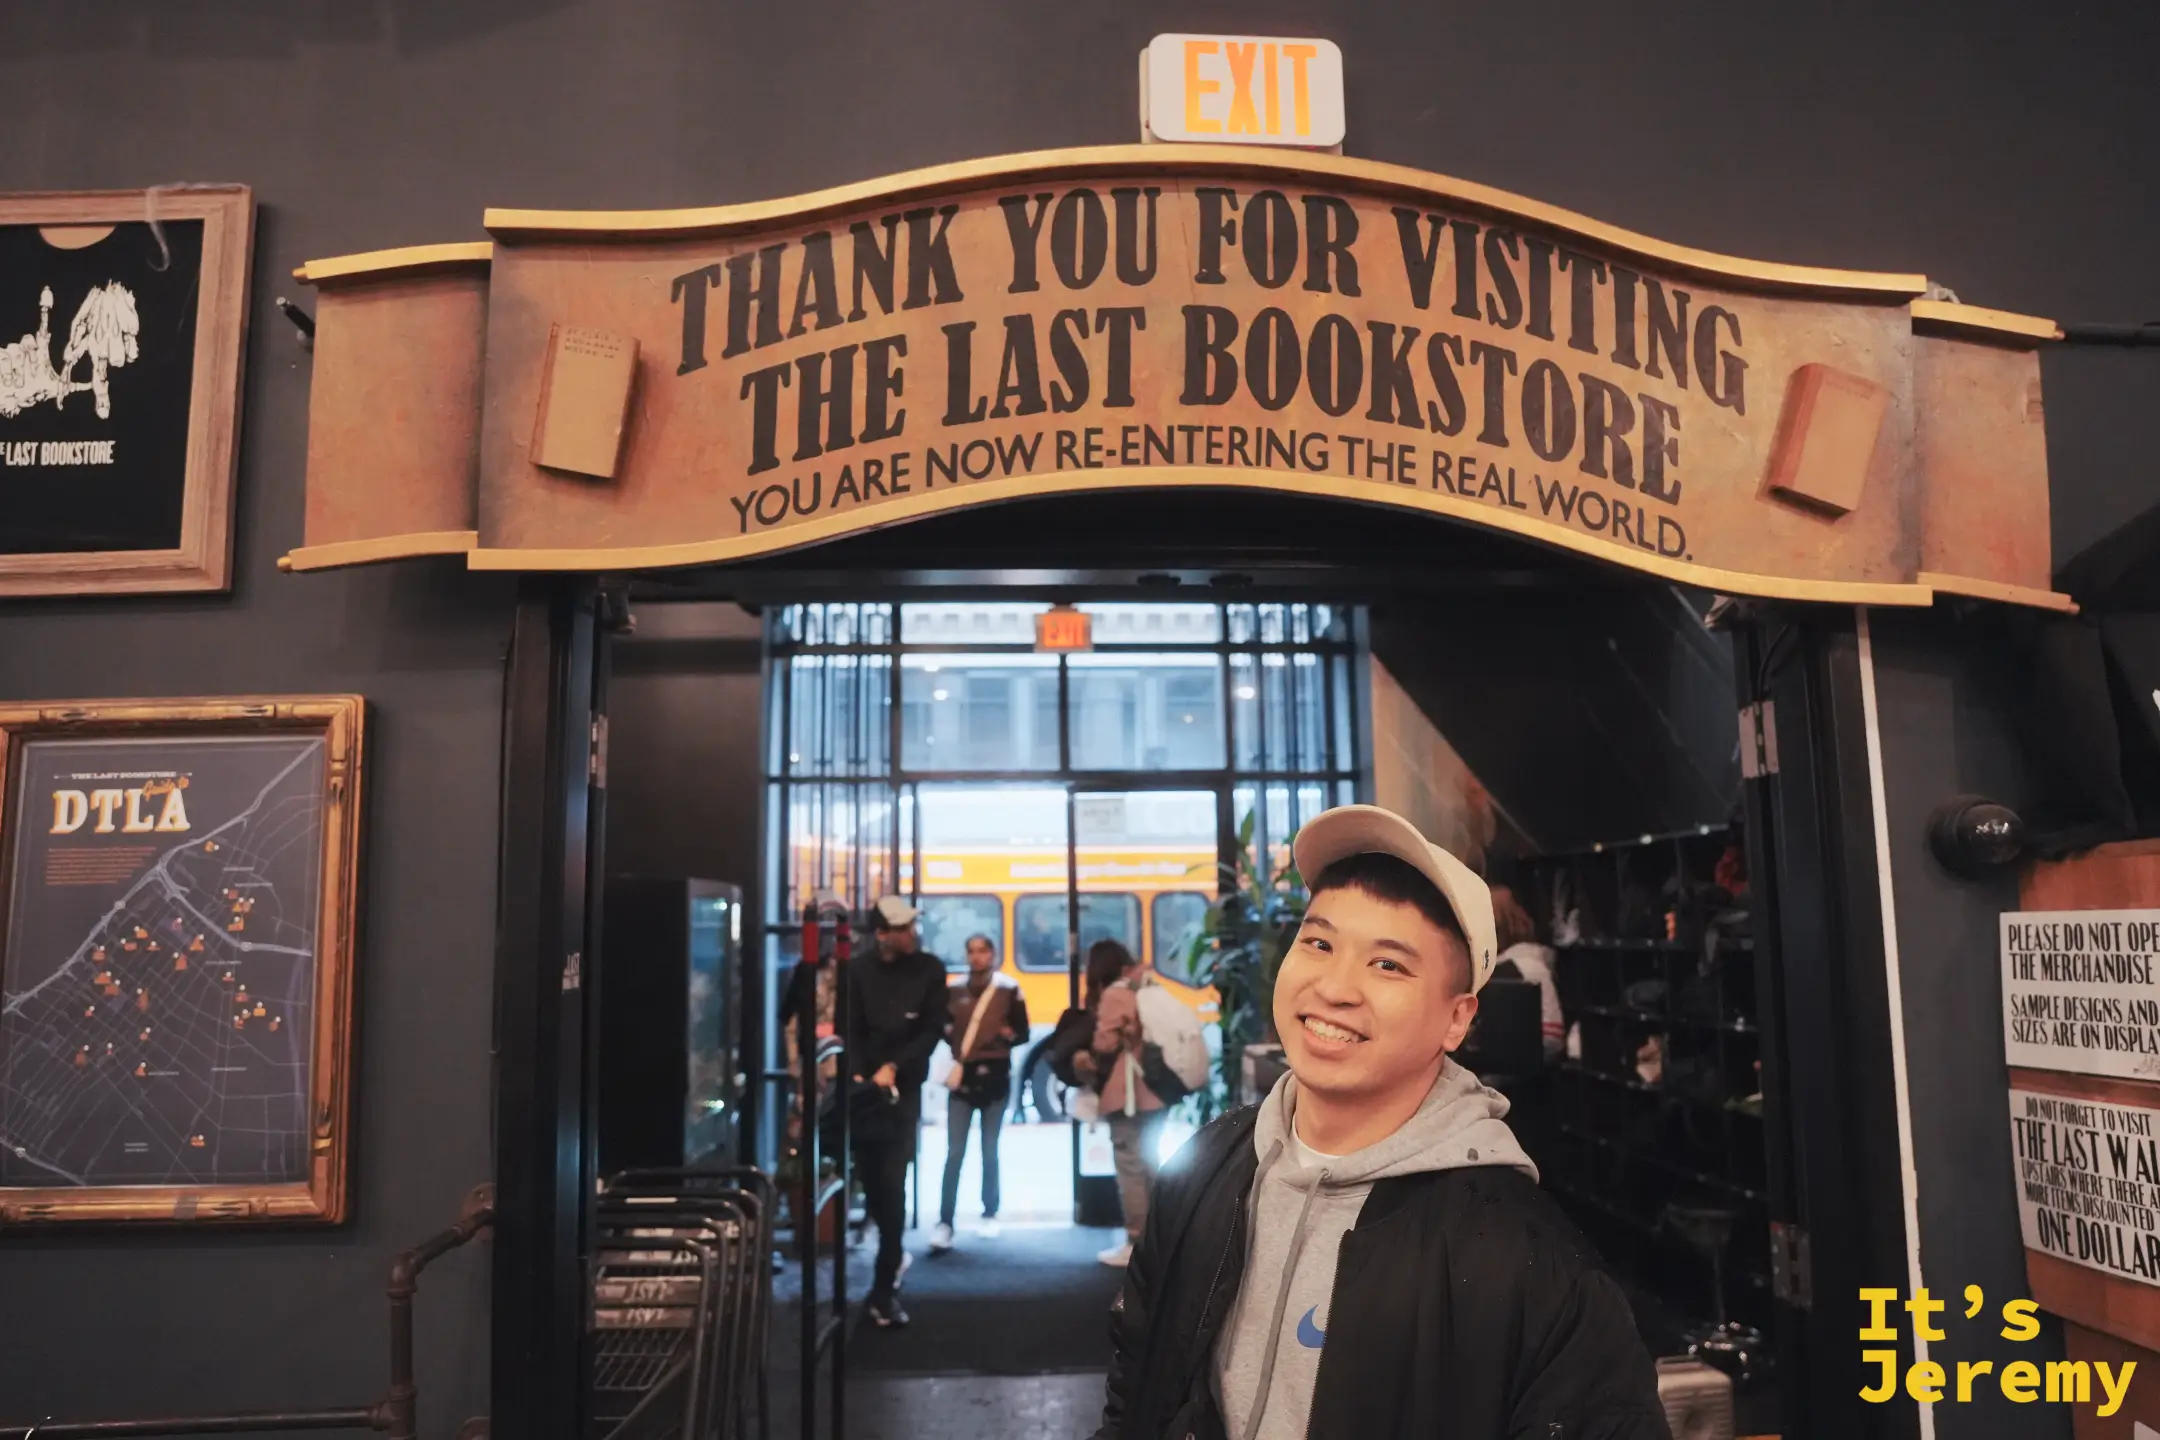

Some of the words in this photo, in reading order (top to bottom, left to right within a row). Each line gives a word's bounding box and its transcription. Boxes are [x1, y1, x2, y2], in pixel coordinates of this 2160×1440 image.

[1183, 40, 1317, 137] EXIT
[669, 204, 964, 377] THANK
[998, 186, 1161, 295] YOU
[1194, 186, 1361, 298] FOR
[1391, 205, 1750, 416] VISITING
[739, 333, 909, 477] THE
[940, 306, 1147, 427] LAST
[1178, 304, 1683, 507] BOOKSTORE
[5, 441, 39, 466] LAST
[40, 440, 116, 466] BOOKSTORE
[730, 473, 823, 534] YOU
[829, 452, 911, 509] ARE
[925, 431, 1044, 488] NOW
[1054, 424, 1331, 472] RE-ENTERING
[1331, 435, 1416, 485] THE
[1430, 453, 1527, 511] REAL
[1534, 473, 1694, 562] WORLD.
[49, 788, 191, 833] DTLA
[2008, 923, 2060, 951] PLEASE
[2064, 923, 2084, 951] DO
[2088, 922, 2122, 952] NOT
[2009, 953, 2037, 981] THE
[2040, 953, 2155, 985] MERCHANDISE
[2010, 993, 2060, 1021] SAMPLE
[2063, 996, 2123, 1025] DESIGNS
[2127, 999, 2159, 1026] AND
[2012, 1018, 2048, 1045] SIZES
[2052, 1021, 2078, 1048] ARE
[2080, 1023, 2100, 1049] ON
[2104, 1025, 2160, 1055] DISPLA
[2025, 1096, 2038, 1118] DO
[2039, 1099, 2058, 1122] NOT
[2060, 1102, 2096, 1128] FORGET
[2099, 1107, 2116, 1131] TO
[2118, 1111, 2151, 1136] VISIT
[2013, 1117, 2048, 1163] THE
[2051, 1123, 2100, 1173] LAST
[2021, 1159, 2067, 1189] UPSTAIRS
[2068, 1169, 2104, 1198] WHERE
[2107, 1177, 2145, 1207] THERE
[2025, 1180, 2050, 1205] MORE
[2050, 1185, 2082, 1214] ITEMS
[2083, 1193, 2155, 1231] DISCOUNTED
[2037, 1207, 2074, 1257] ONE
[2076, 1217, 2160, 1280] DOLLAR
